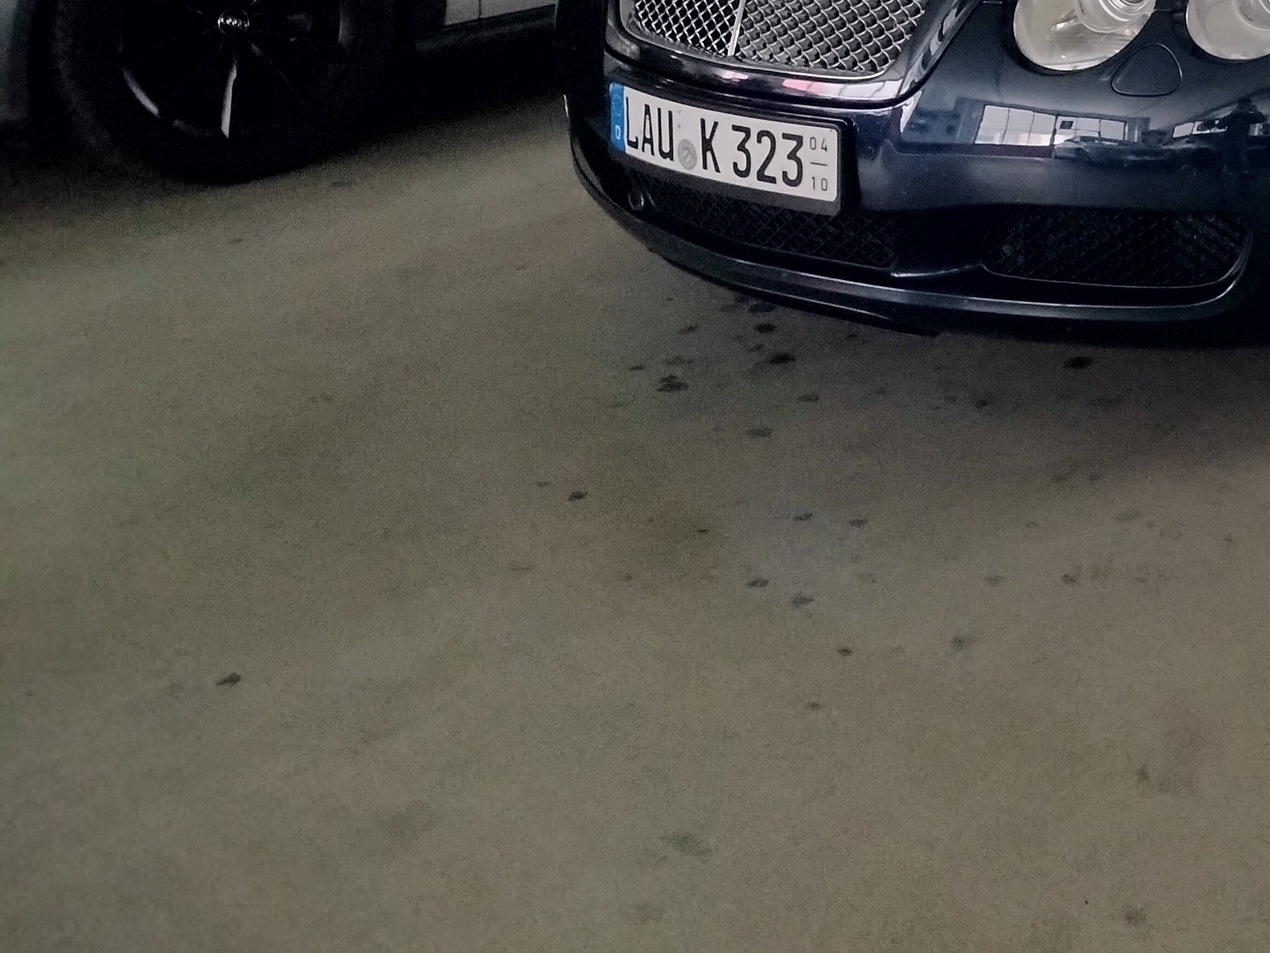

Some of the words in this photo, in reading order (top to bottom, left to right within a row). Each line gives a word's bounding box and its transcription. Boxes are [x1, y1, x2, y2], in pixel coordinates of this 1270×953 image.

[625, 96, 675, 162] LAU
[700, 117, 721, 174] K
[731, 124, 804, 188] 323
[809, 136, 828, 152] 04
[811, 176, 828, 192] 10
